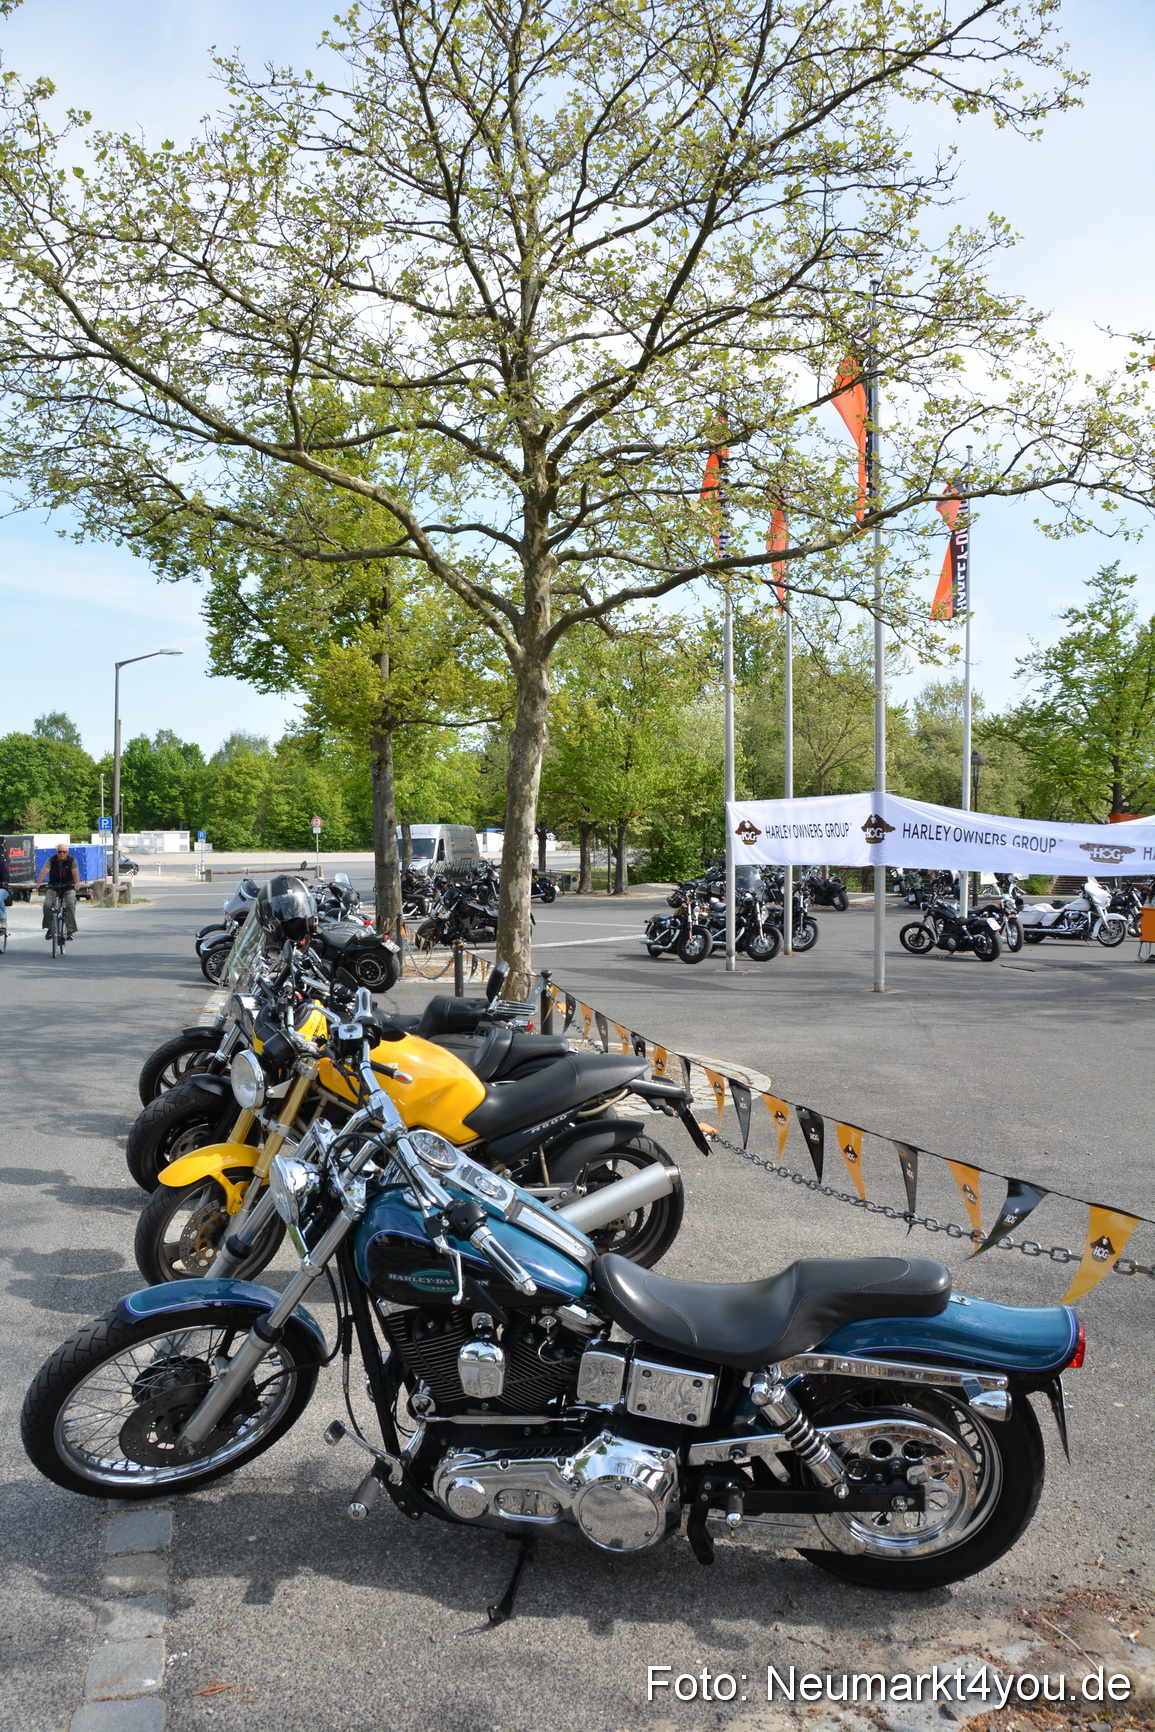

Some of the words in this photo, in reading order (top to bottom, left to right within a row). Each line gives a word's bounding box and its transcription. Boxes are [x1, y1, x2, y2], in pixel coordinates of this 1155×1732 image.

[101, 818, 109, 829] P
[765, 824, 792, 840] HARLEY
[792, 823, 824, 839] OWNERS
[824, 822, 850, 838] GROUP
[902, 822, 952, 842] HARLEY
[953, 827, 1007, 847] OWNERS
[1012, 835, 1057, 854] GROUP
[1092, 847, 1121, 860] HOG
[1004, 1214, 1018, 1224] HOG
[1093, 1245, 1109, 1259] HOG
